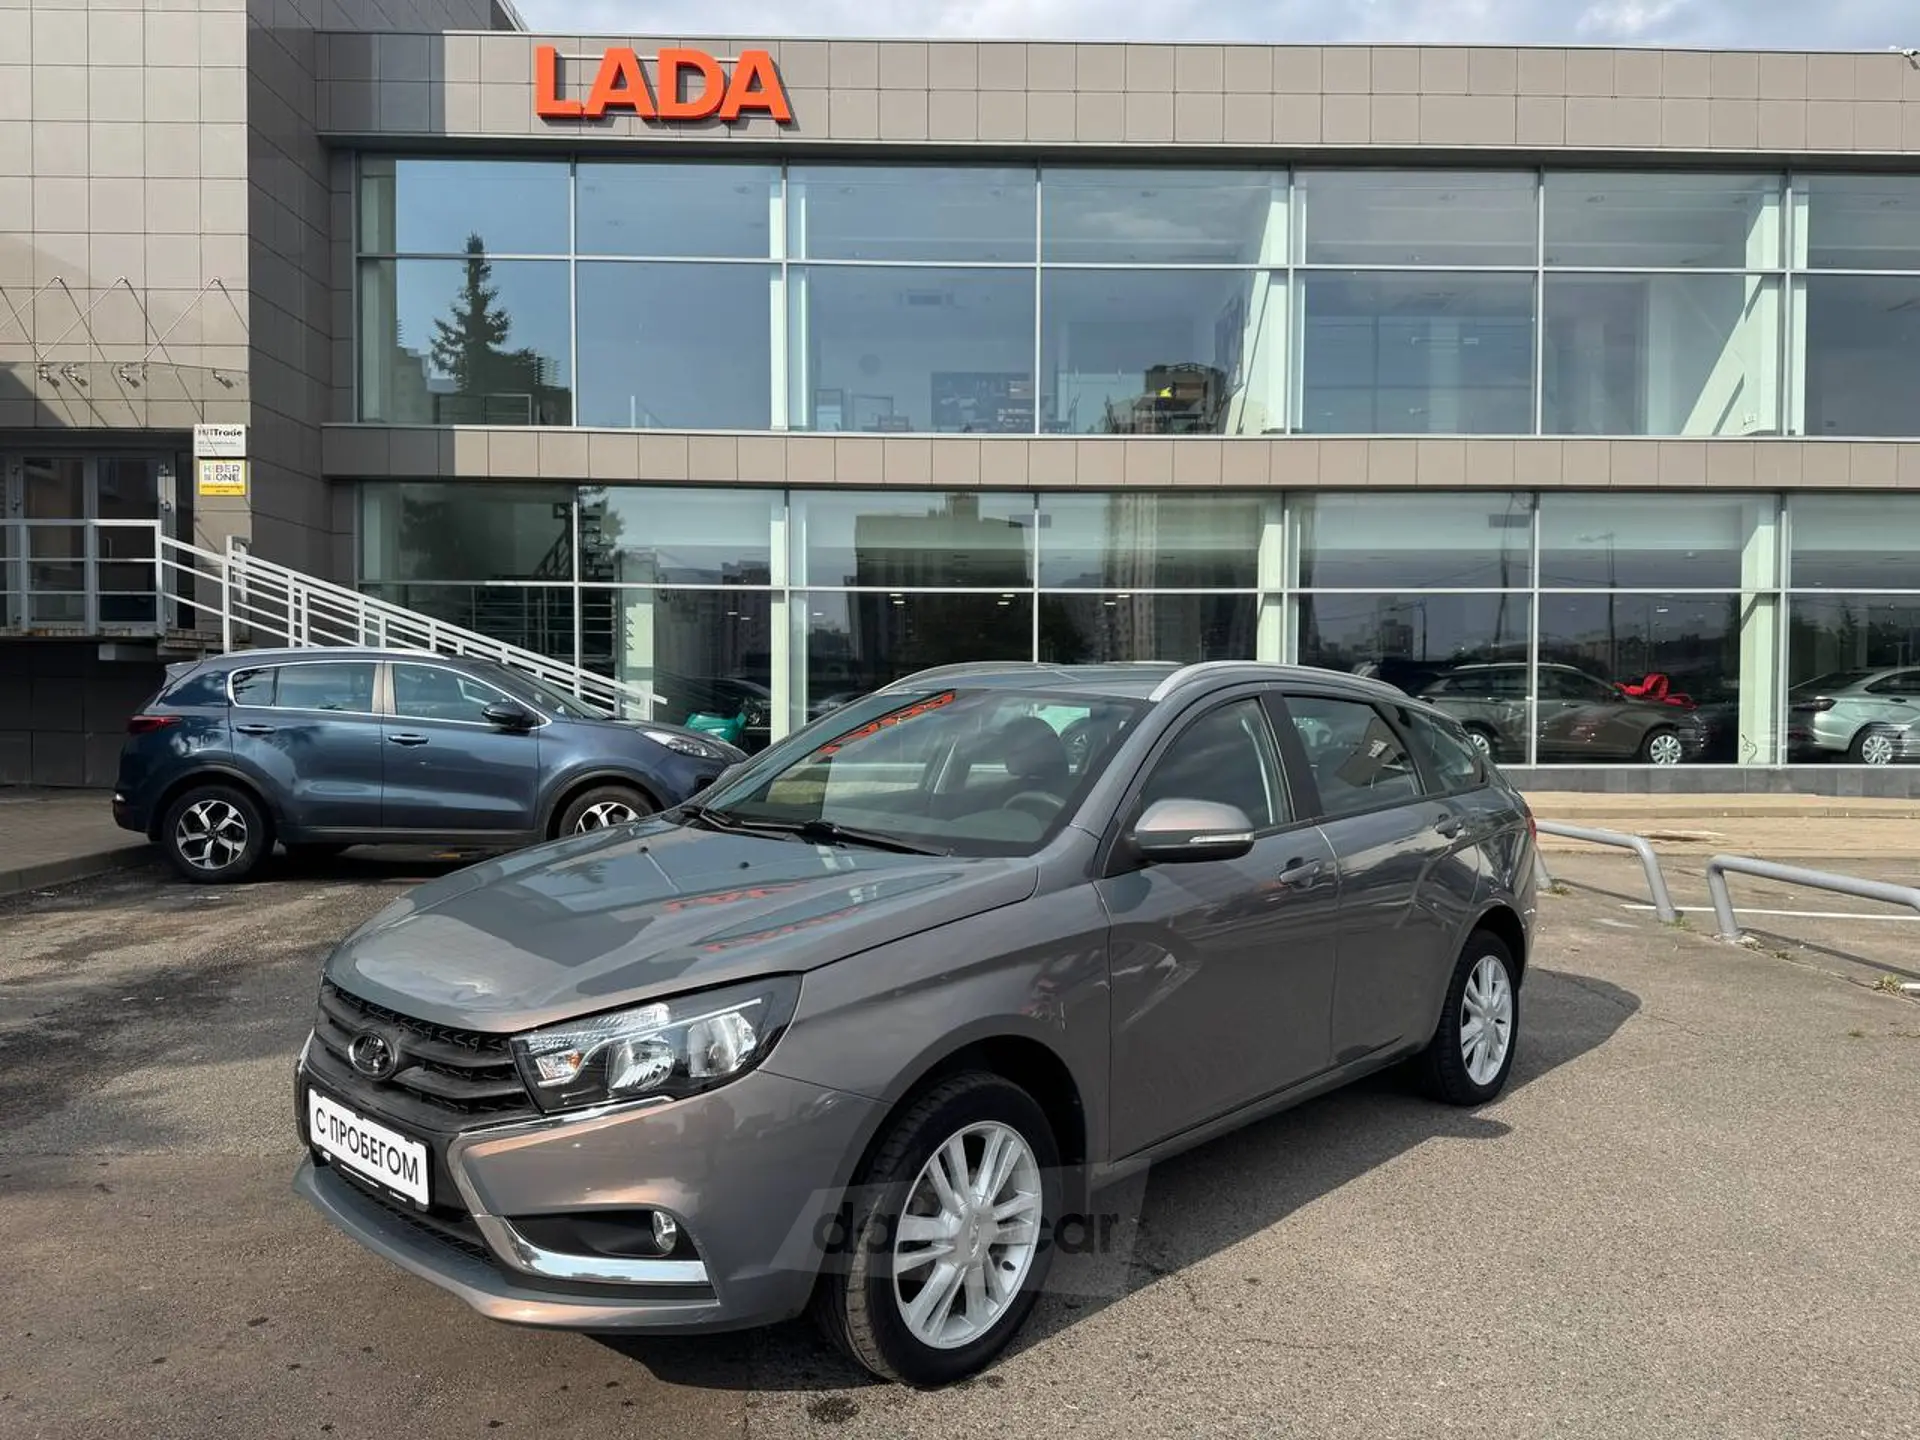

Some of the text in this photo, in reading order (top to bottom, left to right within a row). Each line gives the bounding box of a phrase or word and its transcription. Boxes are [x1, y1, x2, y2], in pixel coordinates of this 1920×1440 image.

[536, 46, 792, 123] LADA
[316, 1107, 327, 1135] С
[329, 1113, 420, 1186] ПРОБЕГОМ
